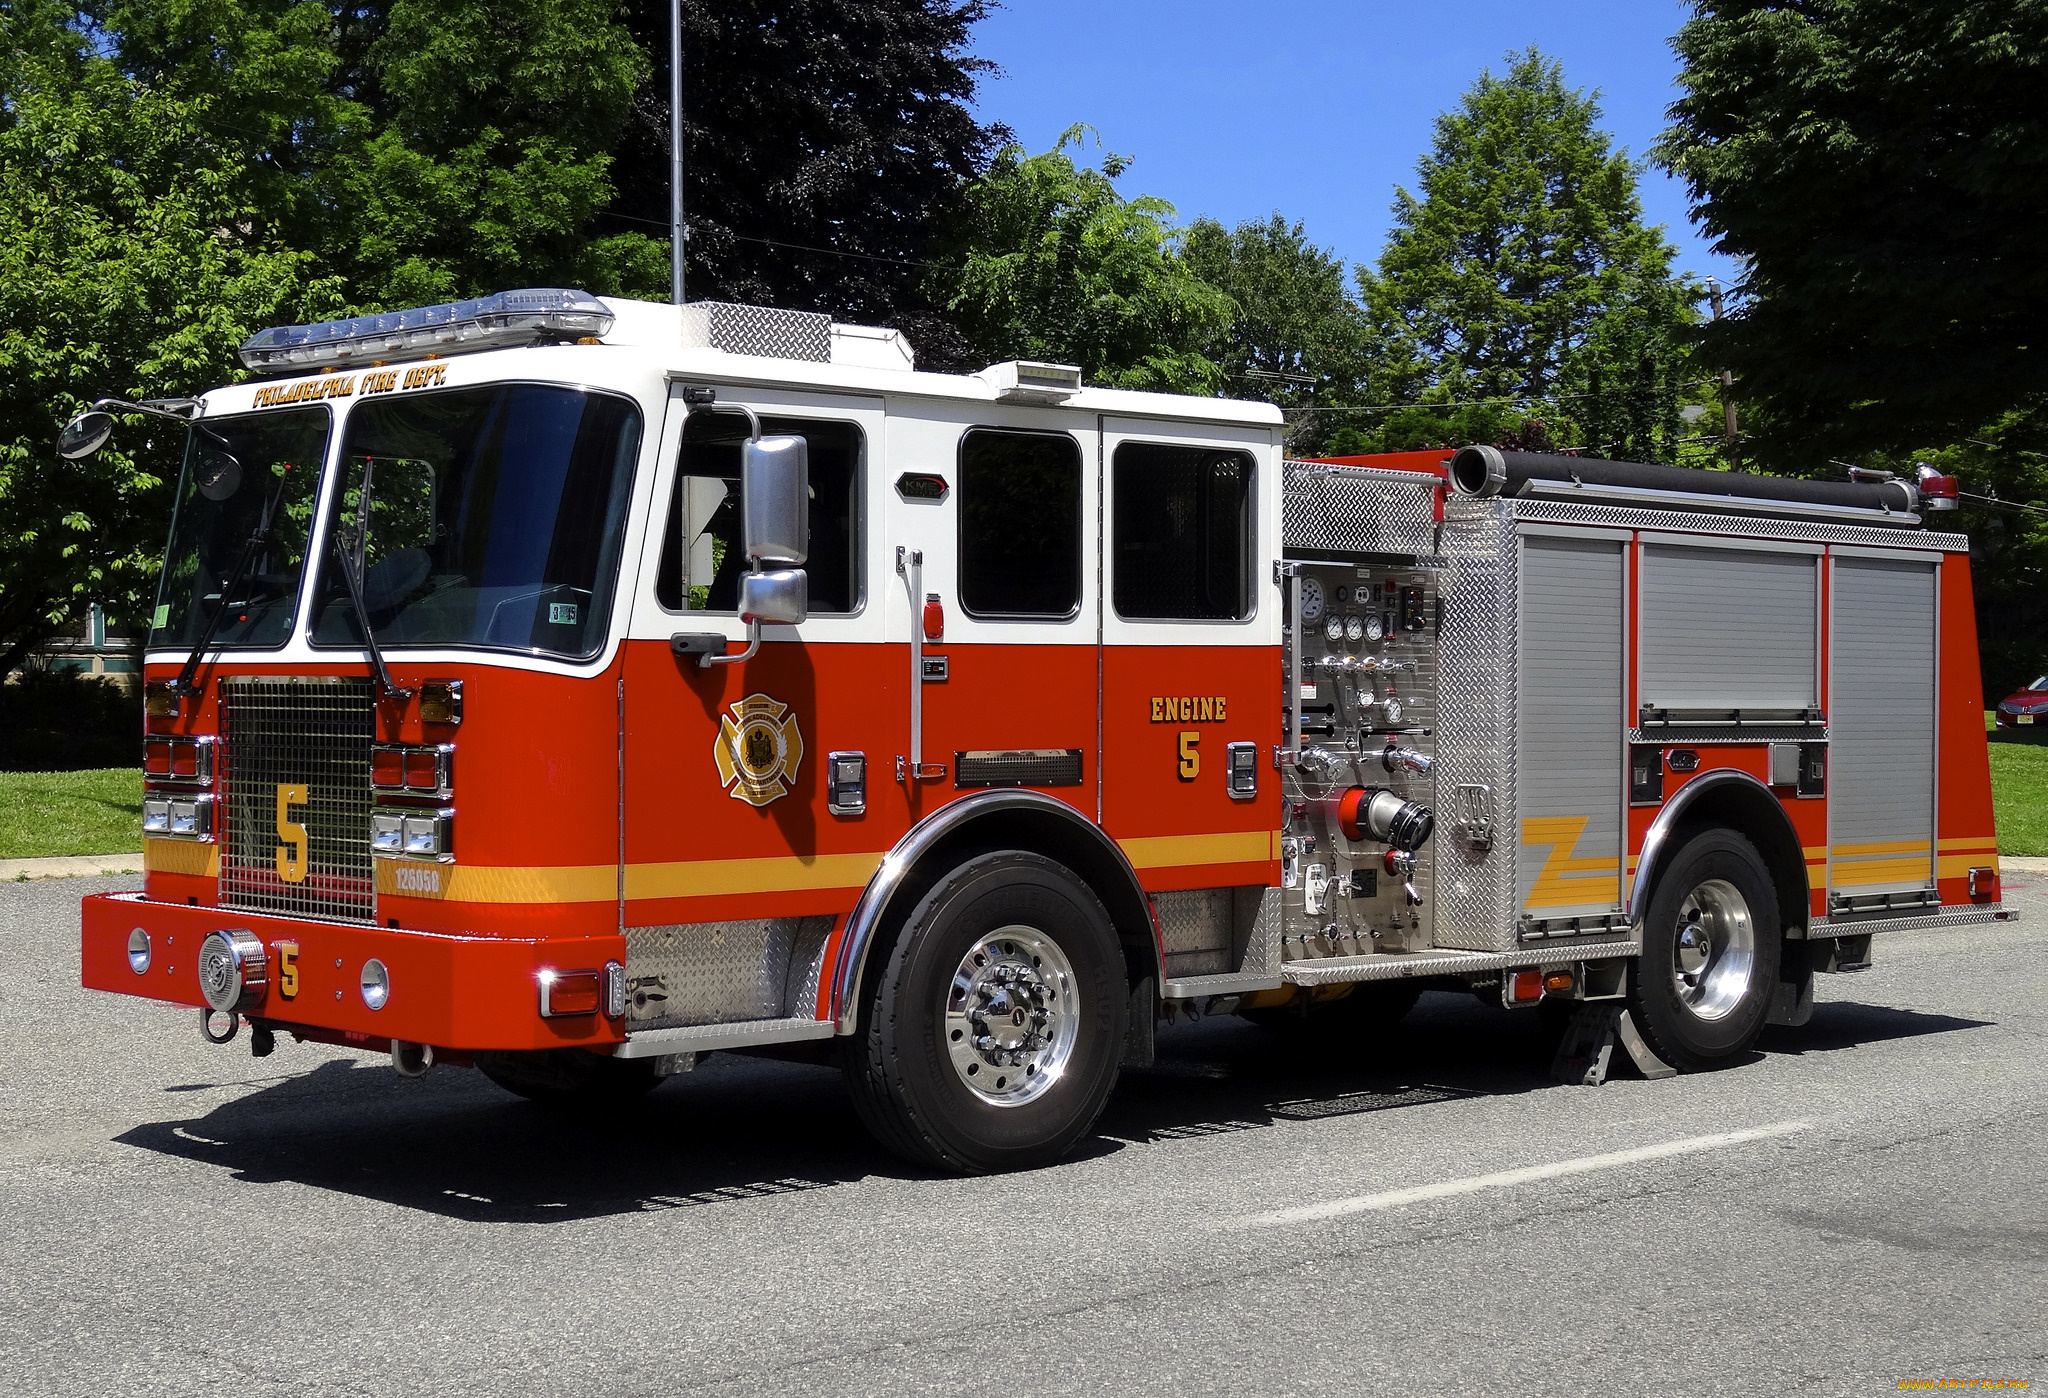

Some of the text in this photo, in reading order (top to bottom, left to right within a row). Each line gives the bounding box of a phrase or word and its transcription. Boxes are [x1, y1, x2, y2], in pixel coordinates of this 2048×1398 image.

[253, 362, 450, 409] PHILADELPHIA FIRE DEPT.
[1150, 696, 1226, 723] ENGINE
[1178, 731, 1200, 783] 5
[276, 783, 308, 883] 5
[280, 943, 299, 999] 5
